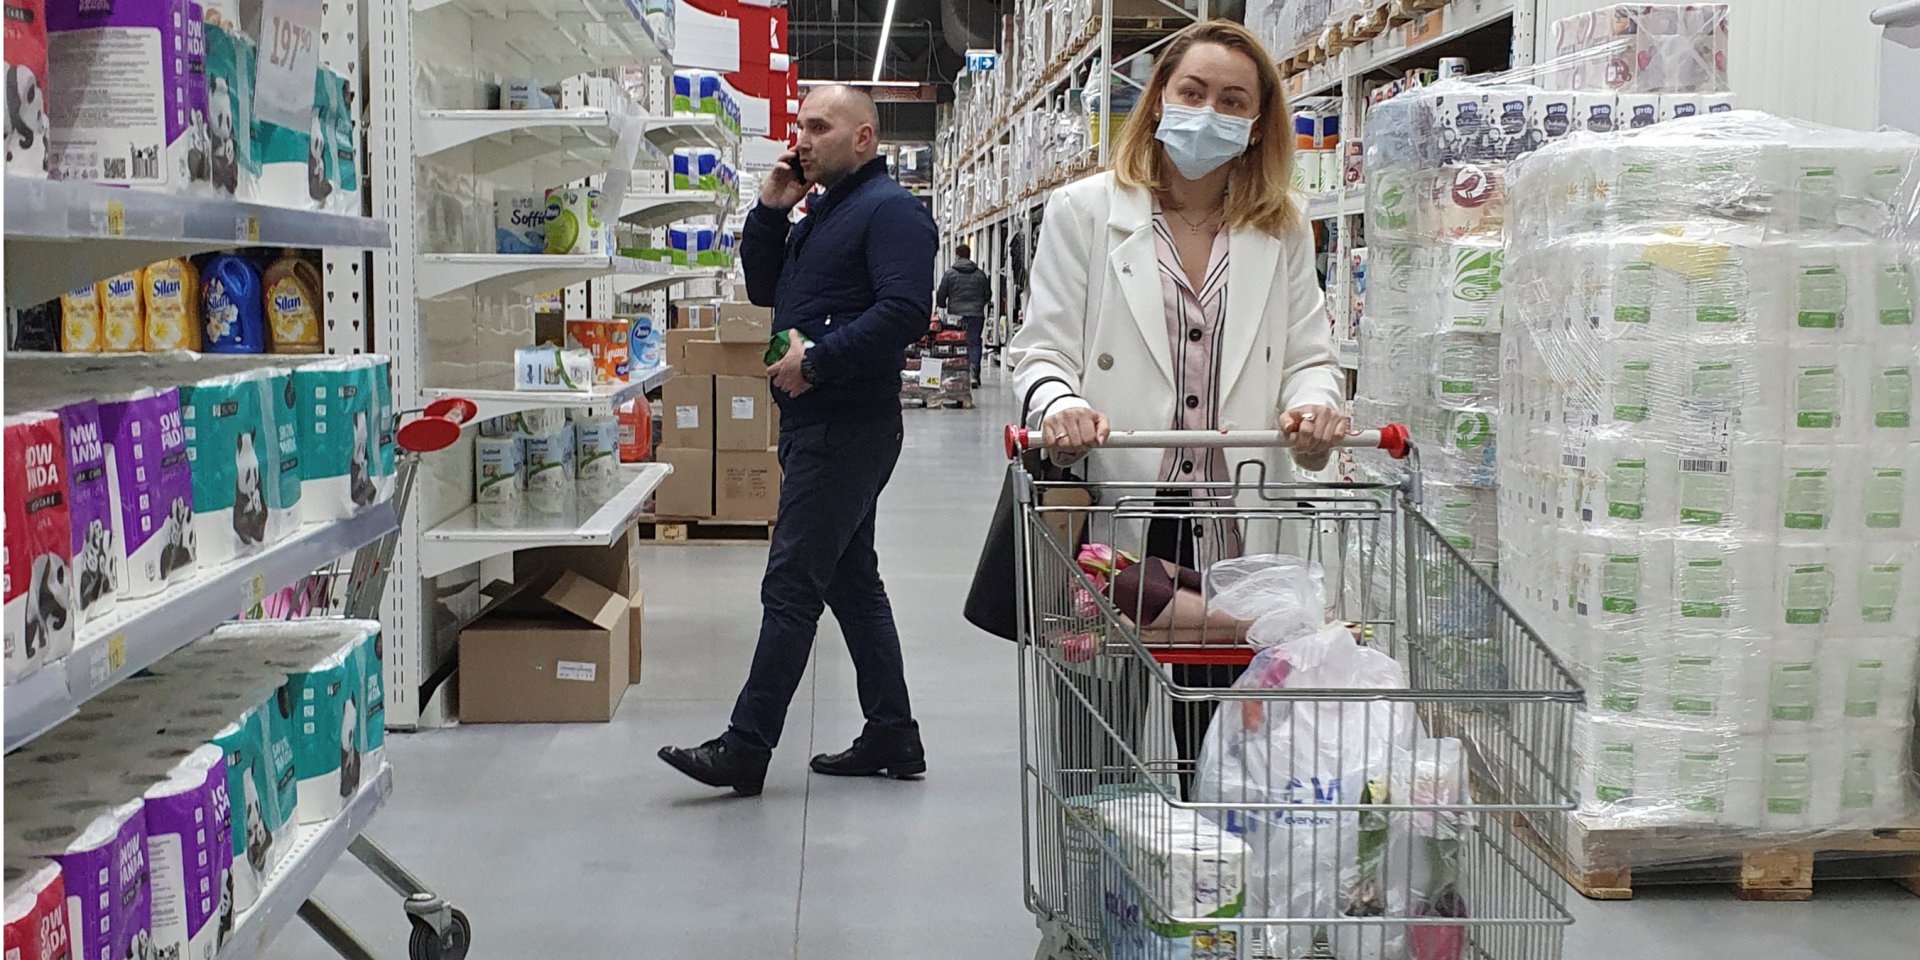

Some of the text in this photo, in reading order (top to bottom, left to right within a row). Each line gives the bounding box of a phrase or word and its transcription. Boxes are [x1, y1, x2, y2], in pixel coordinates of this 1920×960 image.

[108, 279, 133, 297] Silan
[153, 278, 181, 297] Silan
[275, 296, 301, 311] Silan
